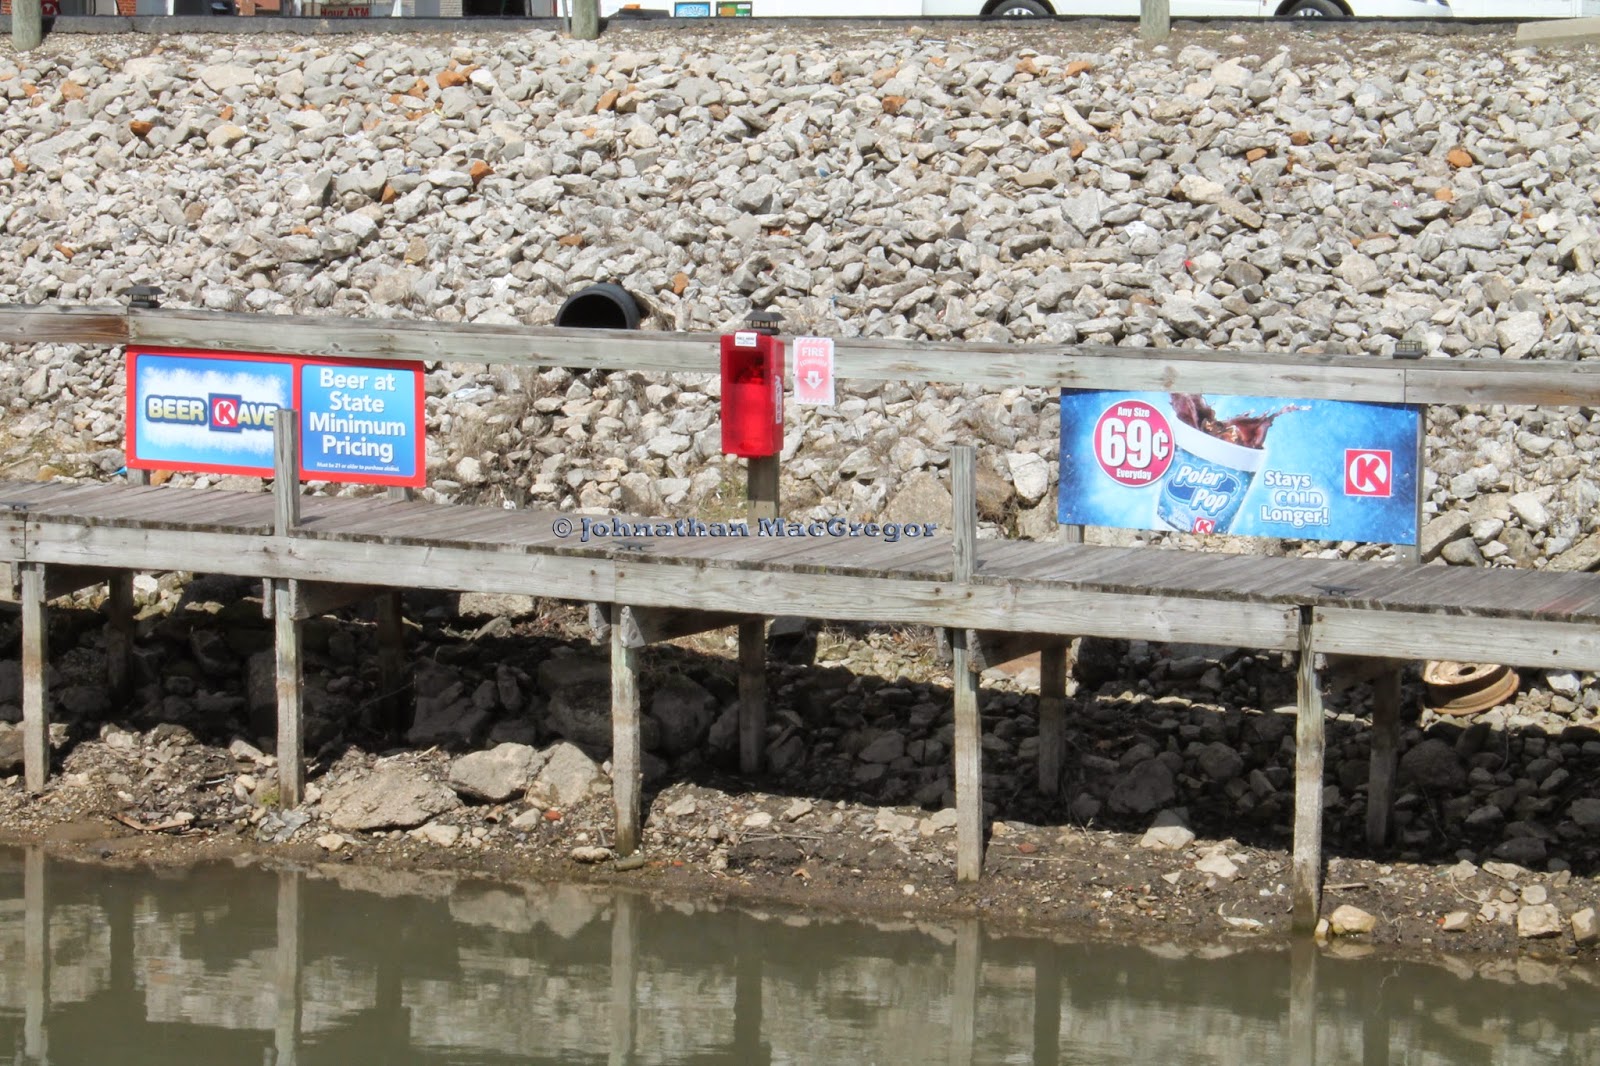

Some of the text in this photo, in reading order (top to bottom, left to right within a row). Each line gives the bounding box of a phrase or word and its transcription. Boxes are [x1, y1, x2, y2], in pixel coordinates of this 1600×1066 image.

[348, 6, 369, 16] ATM
[801, 347, 825, 357] FIRE
[320, 367, 396, 391] Beer at
[148, 397, 206, 422] BEER
[329, 390, 385, 413] State
[1118, 407, 1150, 418] Any Size
[309, 411, 406, 437] Minimum
[322, 434, 394, 463] Pricing
[1101, 418, 1169, 469] 69¢
[1116, 468, 1152, 480] Everyday
[1176, 465, 1224, 486] Polar
[1264, 470, 1311, 491] Stays
[1353, 455, 1388, 492] K
[1191, 488, 1228, 513] Pop
[1275, 490, 1324, 508] COLD
[1261, 505, 1329, 527] Longer!
